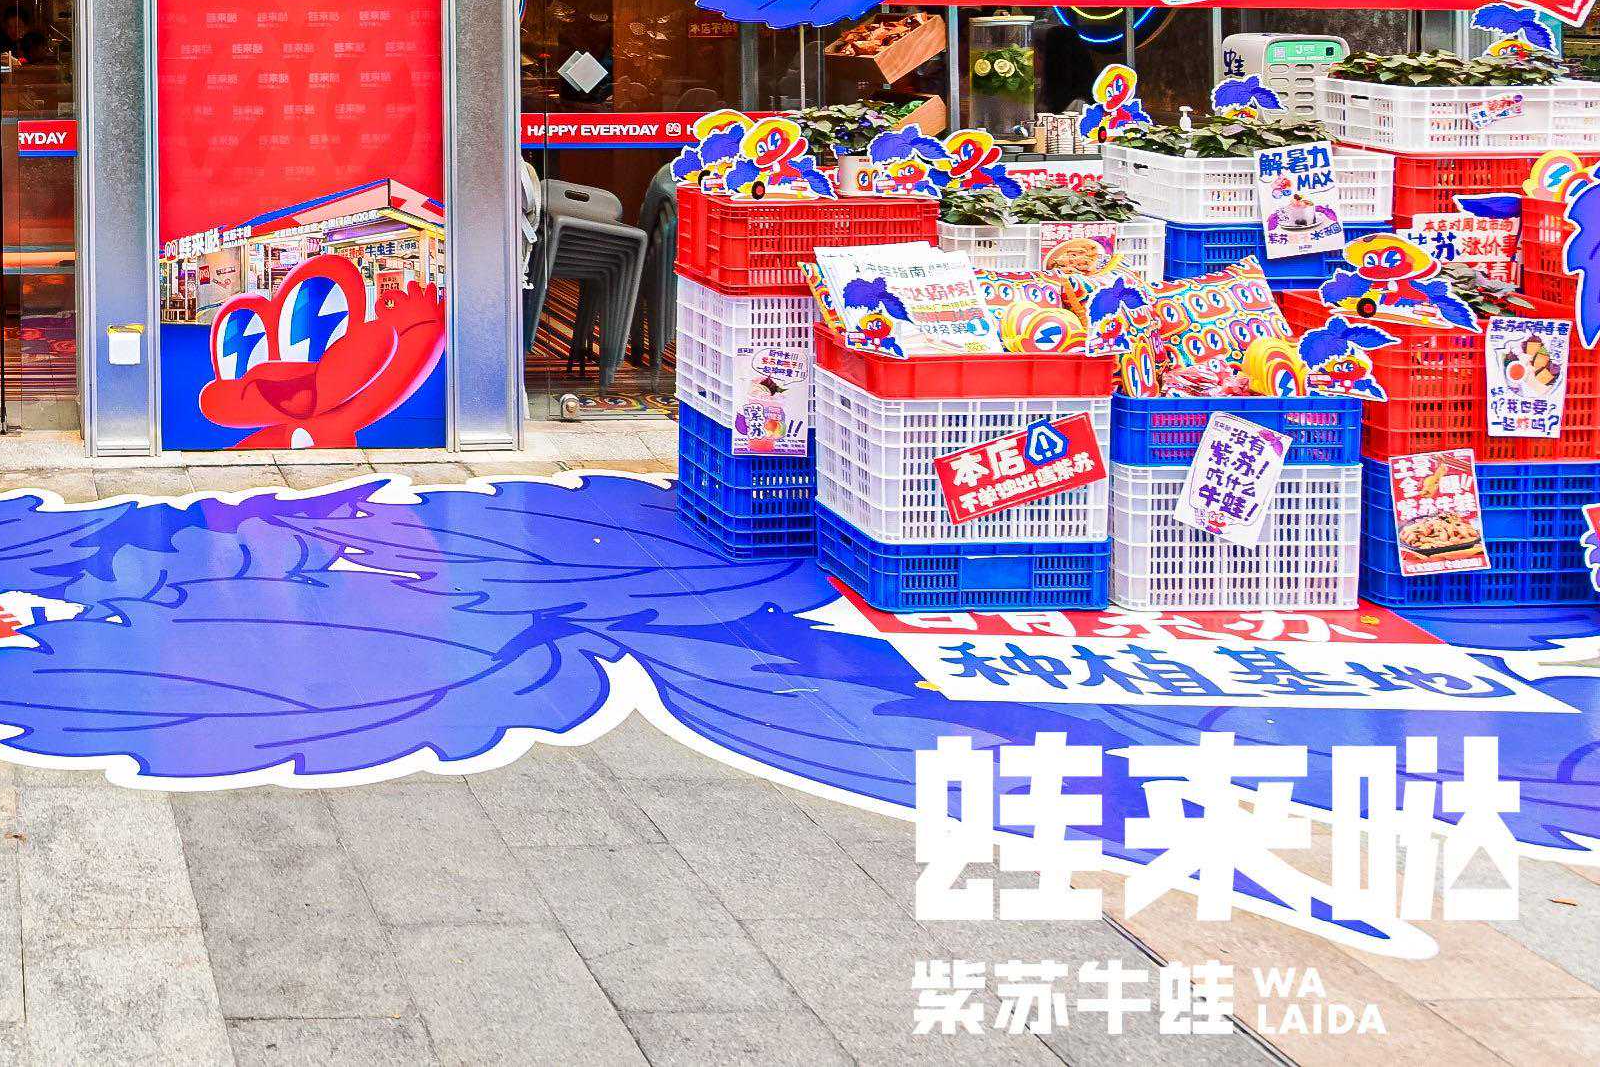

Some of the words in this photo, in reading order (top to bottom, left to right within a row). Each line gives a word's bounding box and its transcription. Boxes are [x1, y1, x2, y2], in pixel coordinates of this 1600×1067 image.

[527, 124, 577, 136] HAPPY
[580, 124, 659, 136] EVERYDAY
[1260, 146, 1331, 177] 解暑力
[1297, 170, 1334, 191] MAX
[1230, 428, 1266, 456] 没有
[950, 438, 1026, 487] 本店
[1208, 440, 1270, 480] 紫苏!
[949, 641, 1518, 699] 种植基地
